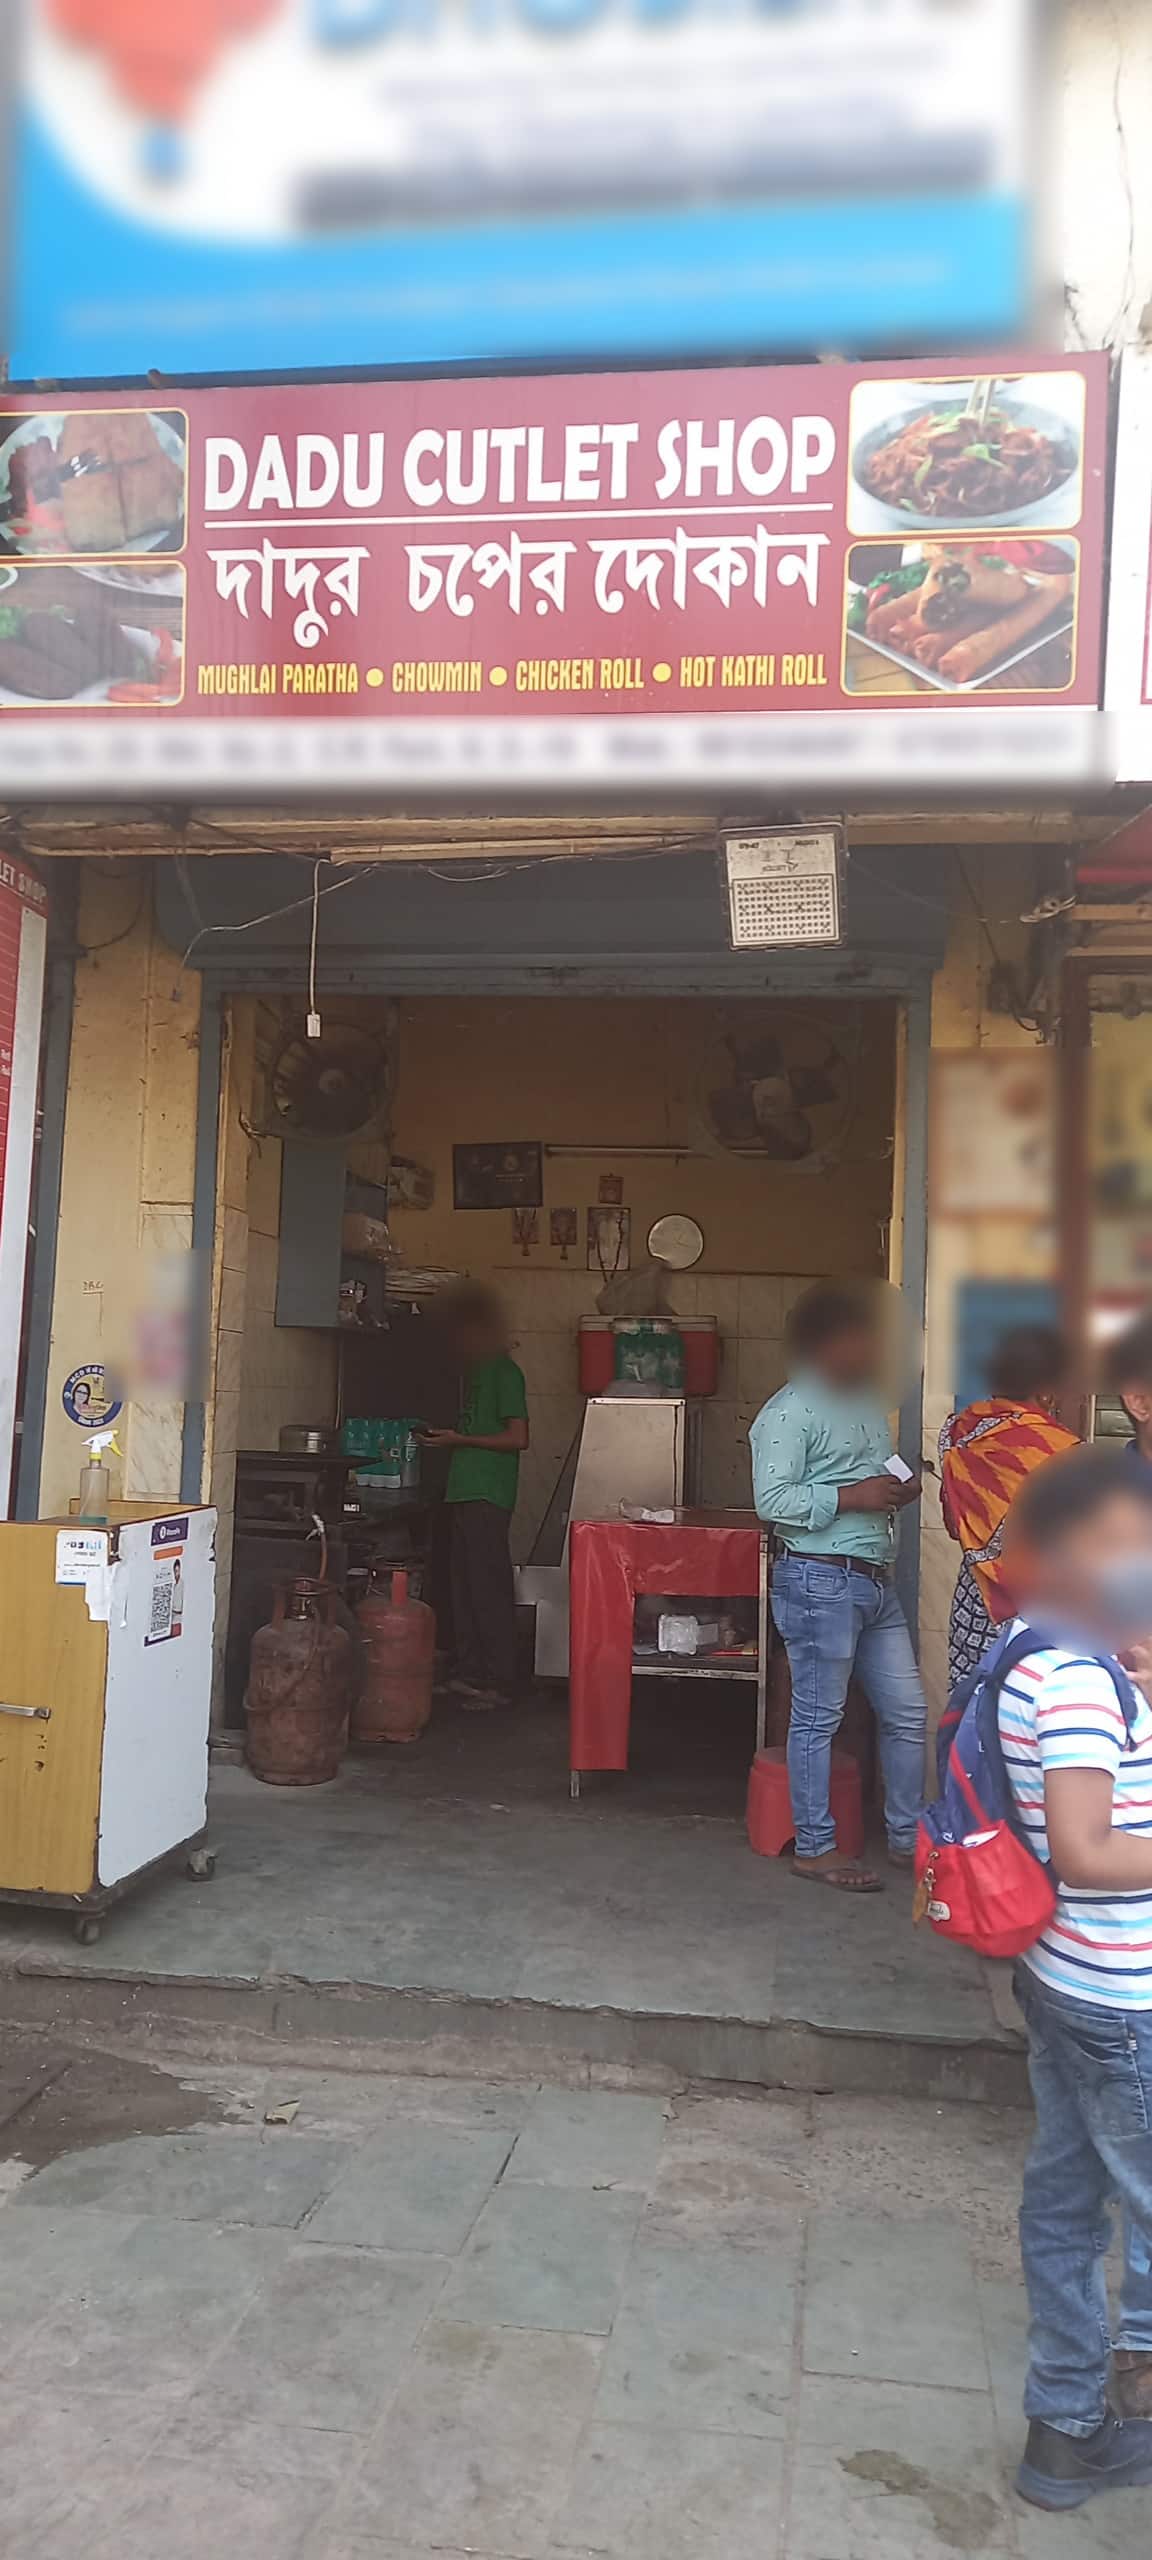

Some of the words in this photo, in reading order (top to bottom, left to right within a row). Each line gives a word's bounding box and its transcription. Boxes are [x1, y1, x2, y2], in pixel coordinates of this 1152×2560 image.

[204, 432, 384, 512] DADU
[403, 422, 639, 507] CUTLET
[655, 415, 837, 501] SHOP
[206, 537, 371, 649] দাদুর
[404, 531, 577, 617] চপের
[587, 524, 831, 614] দোকান
[198, 664, 276, 695] MUGHLAI
[282, 662, 358, 694] PARATHA
[392, 661, 482, 693] CHOWMIN
[516, 659, 594, 691] CHICKEN
[600, 658, 645, 689] ROLL
[680, 656, 716, 687] HOT
[721, 655, 775, 687] KATHI
[781, 654, 827, 685] ROLL
